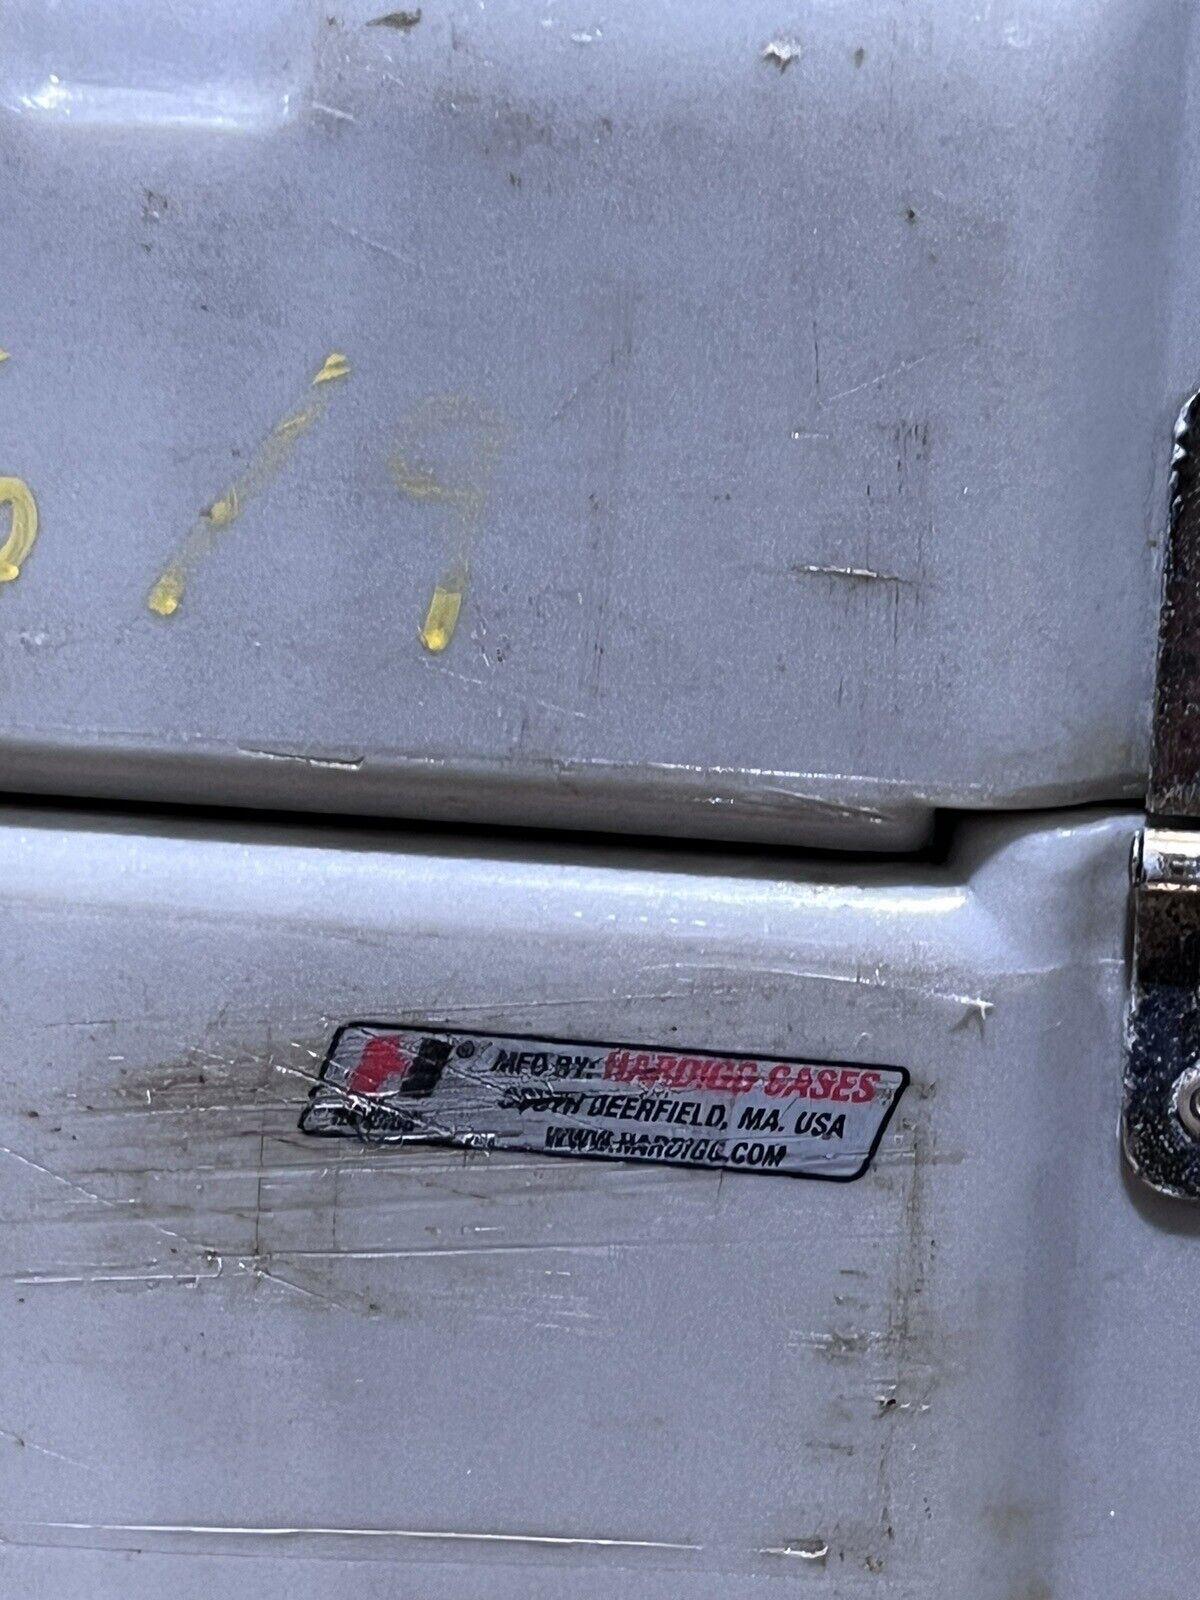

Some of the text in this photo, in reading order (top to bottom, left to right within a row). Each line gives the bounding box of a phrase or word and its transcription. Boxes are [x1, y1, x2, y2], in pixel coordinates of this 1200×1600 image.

[762, 1063, 881, 1104] CASES
[587, 1093, 728, 1131] DEERFIELD,
[728, 1106, 785, 1133] MA.
[794, 1111, 847, 1139] USA
